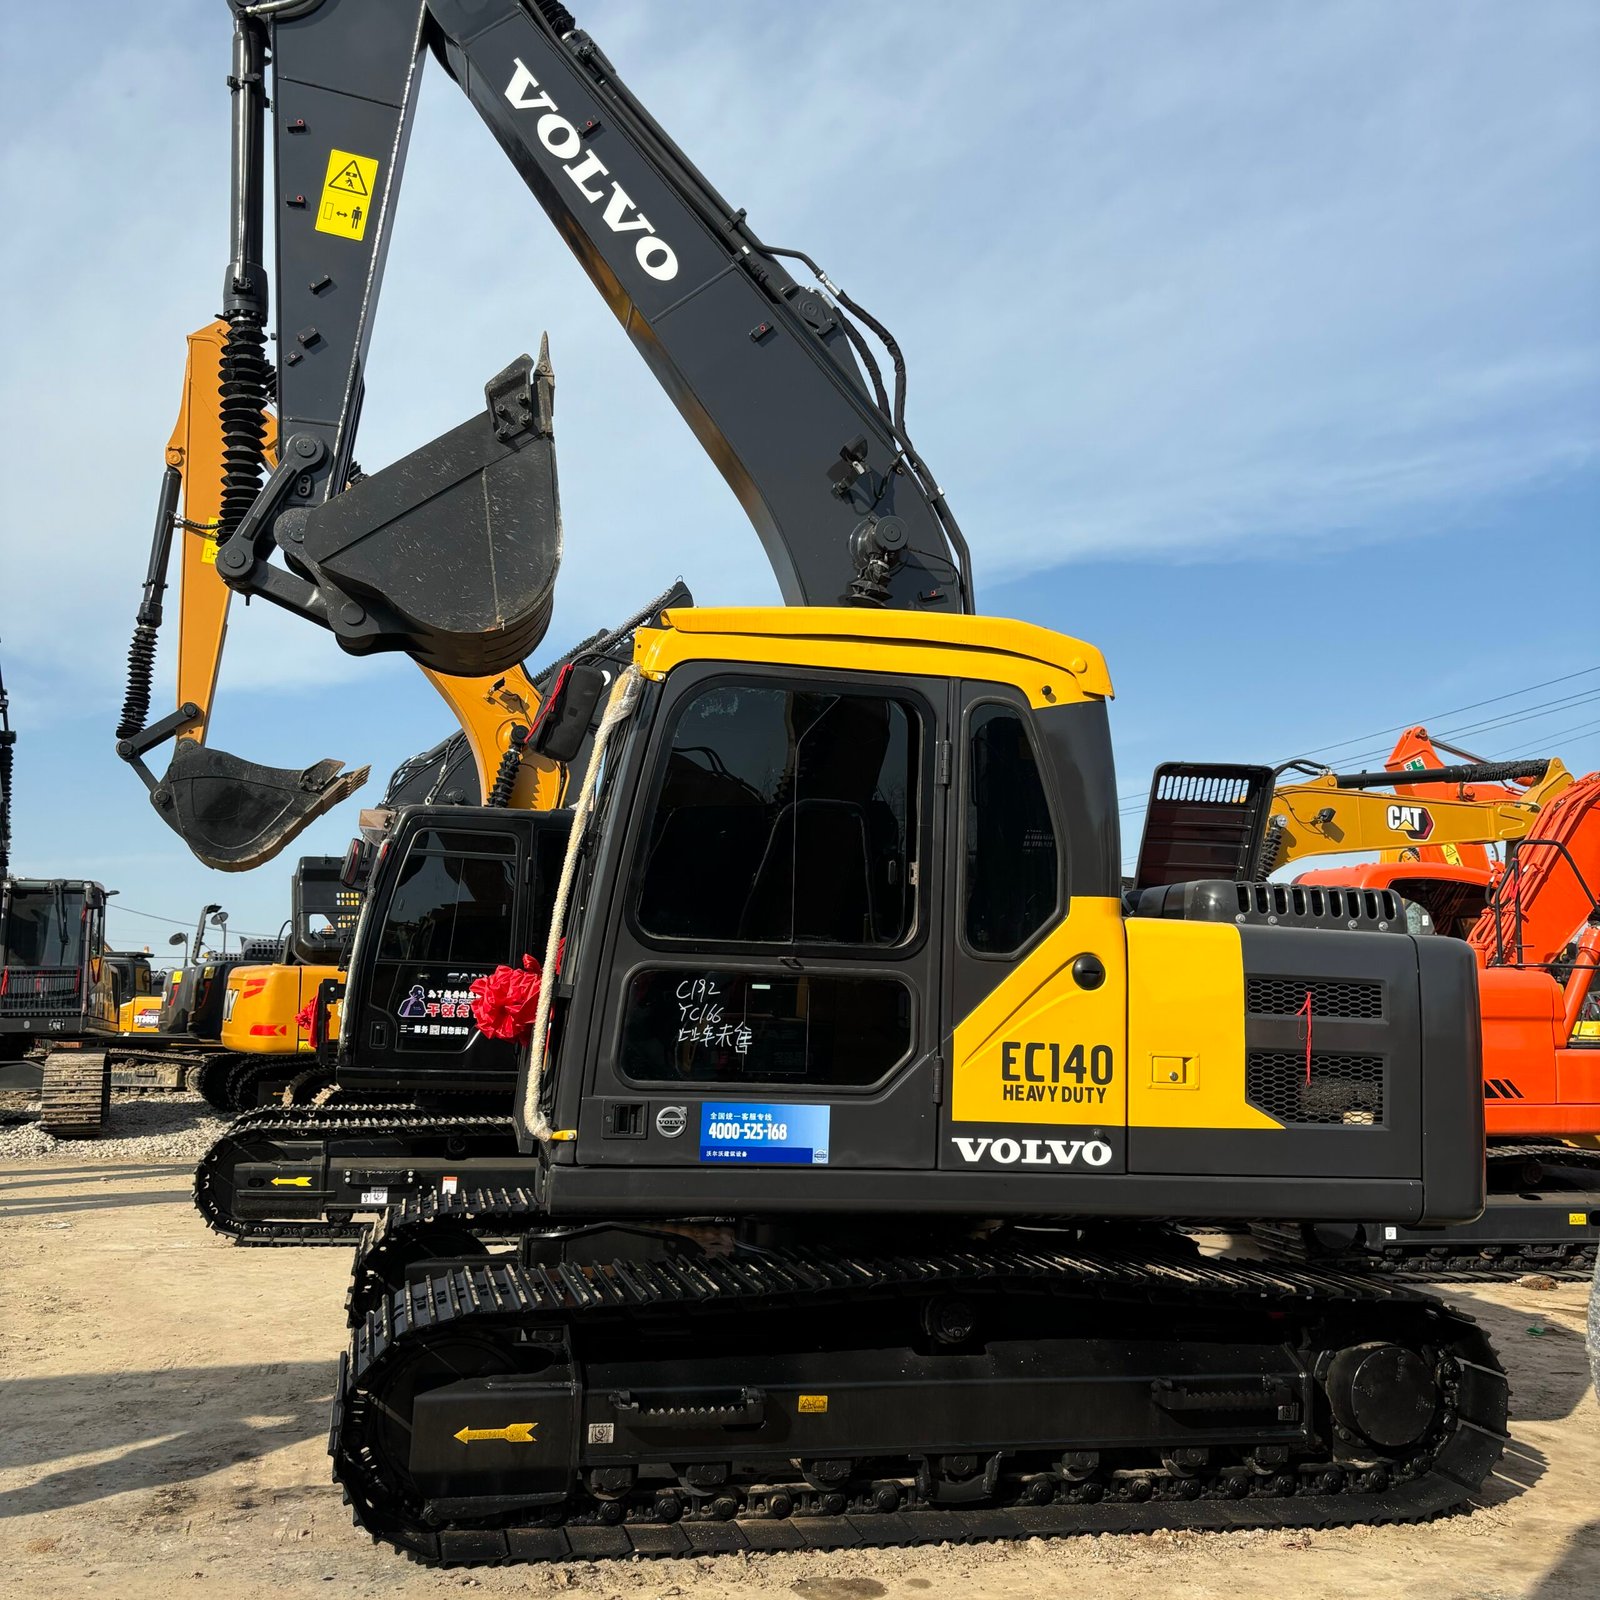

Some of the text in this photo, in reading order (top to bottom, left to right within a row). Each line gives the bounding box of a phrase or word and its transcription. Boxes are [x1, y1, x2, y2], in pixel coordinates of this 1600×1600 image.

[504, 57, 678, 281] VOLVO
[1388, 806, 1422, 831] CAT
[676, 978, 721, 1003] C192
[678, 1002, 724, 1023] YC166
[1002, 1042, 1113, 1085] EC140
[1003, 1085, 1107, 1104] HEAVY DUTY
[710, 1112, 773, 1121] 全国统一客服专线
[708, 1122, 788, 1140] 4000-525-168
[951, 1137, 1113, 1166] VOLVO
